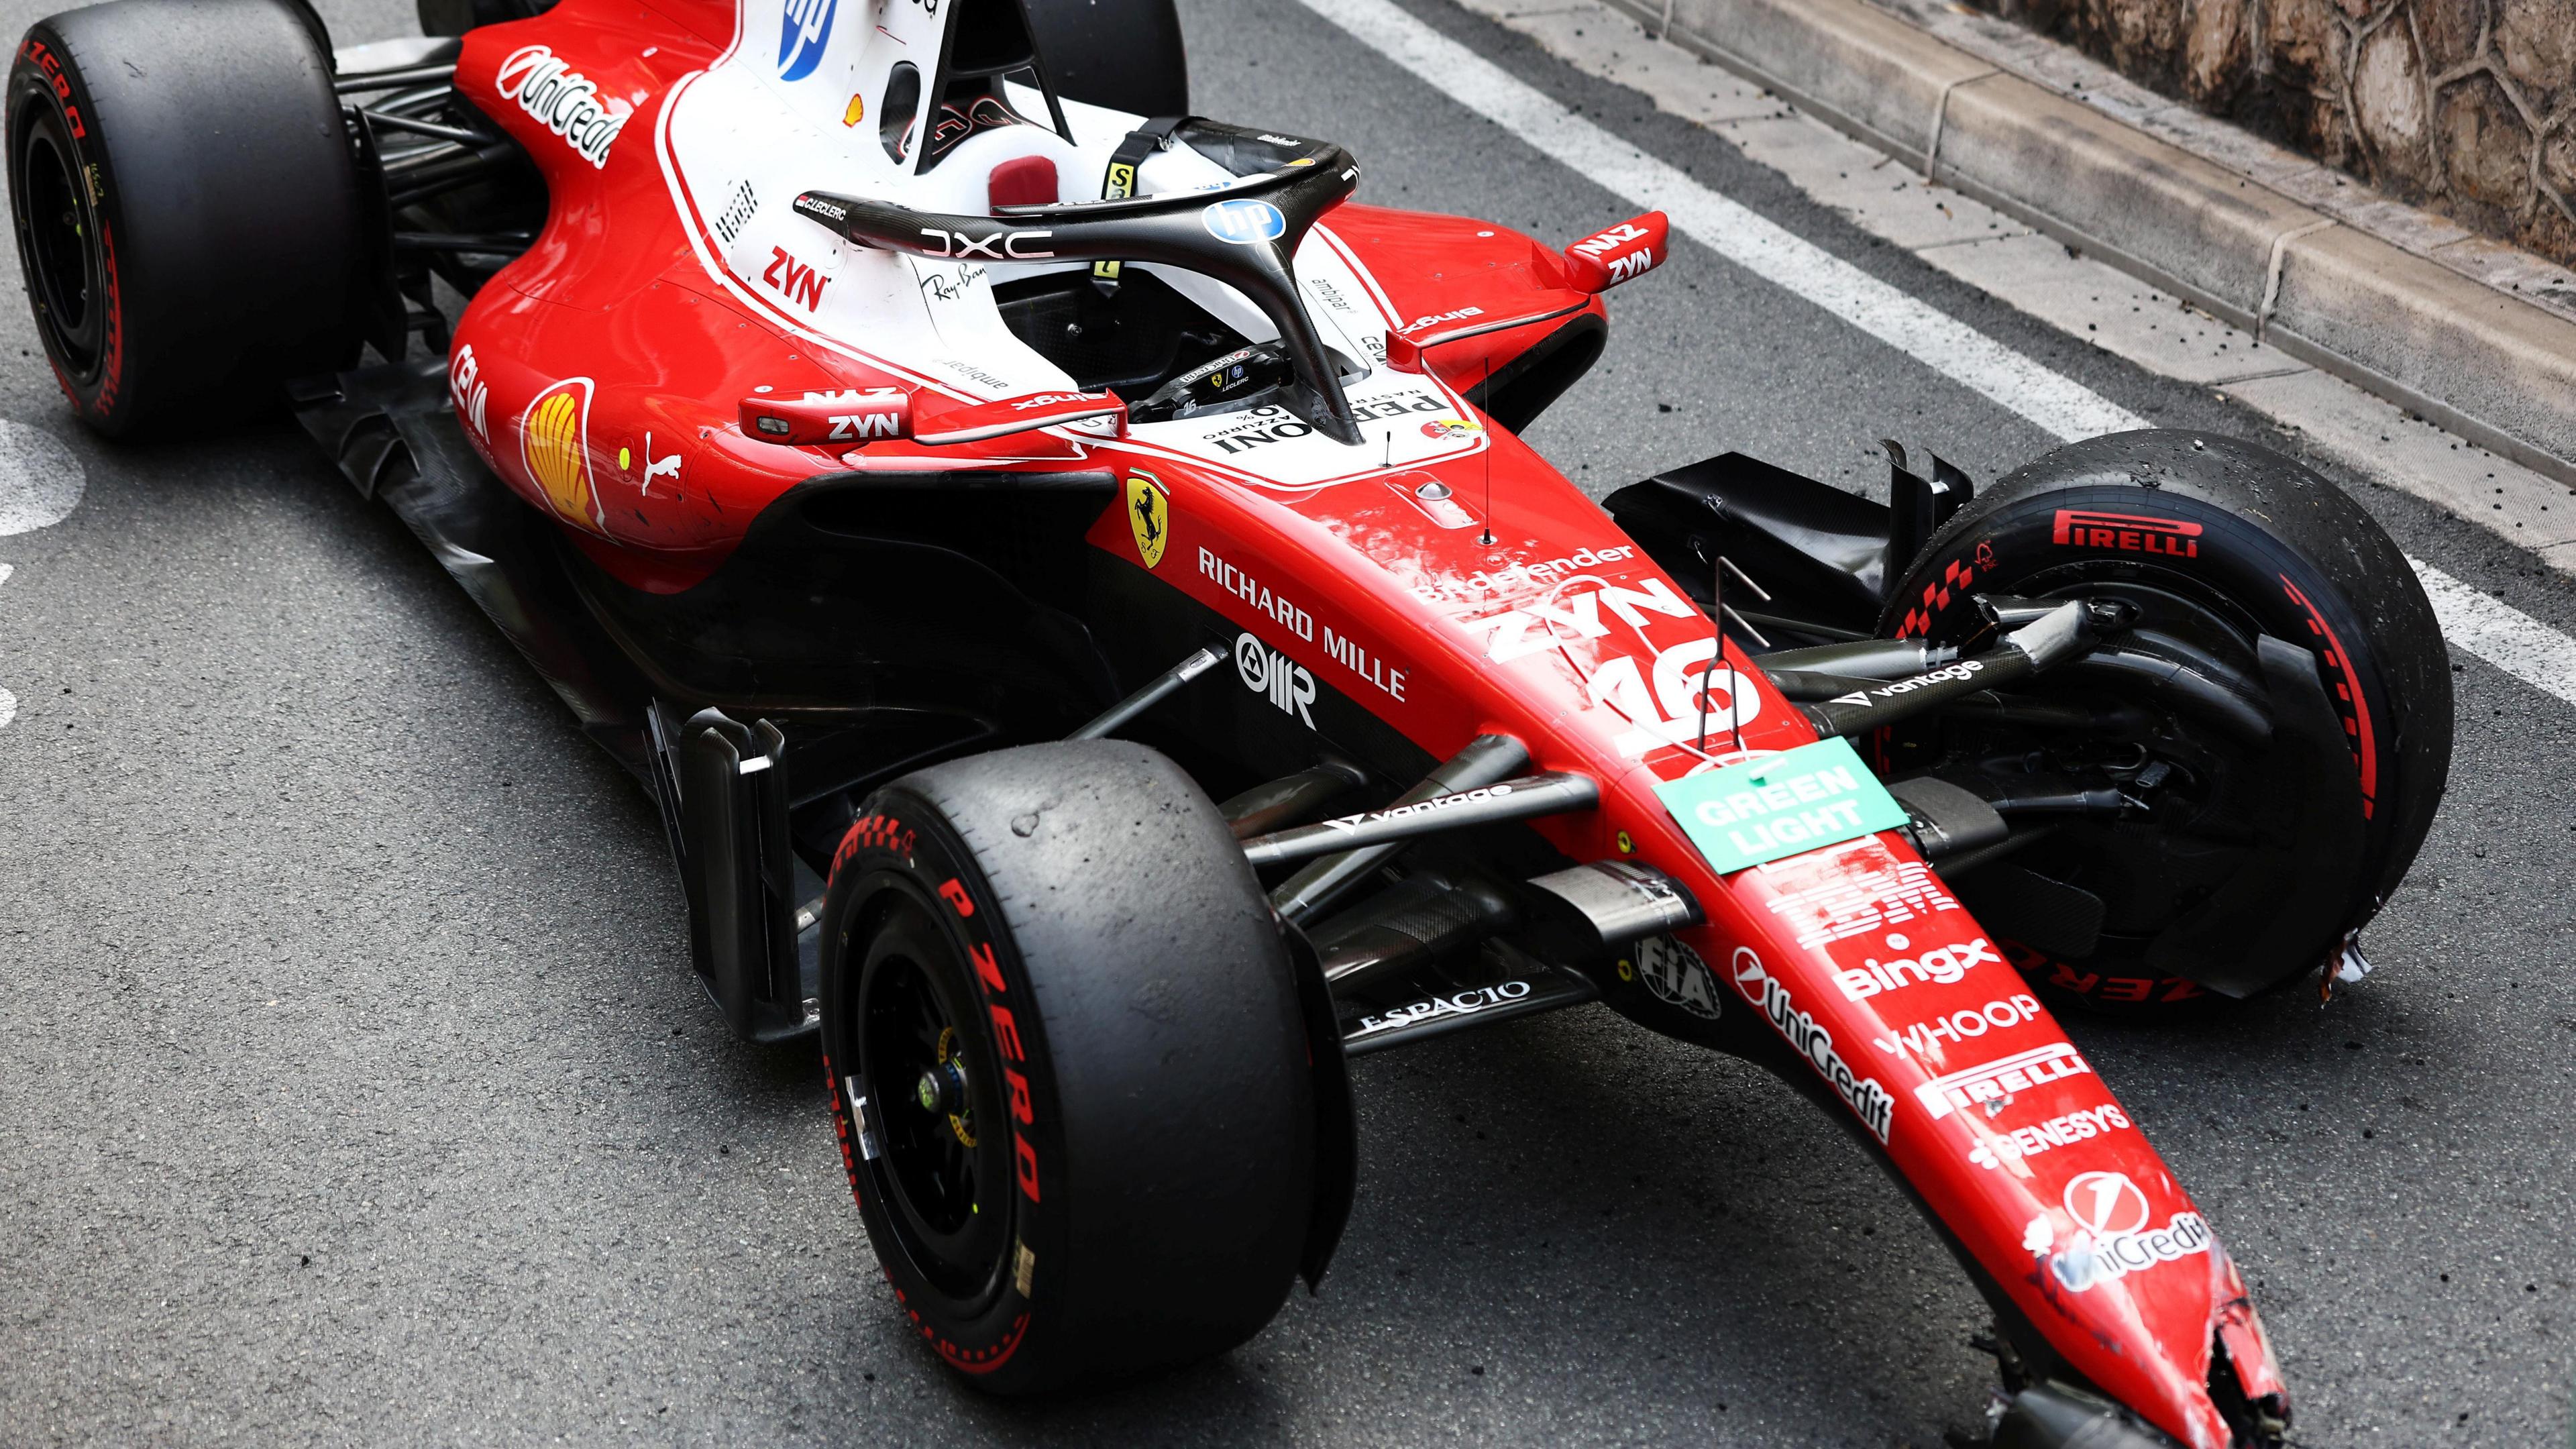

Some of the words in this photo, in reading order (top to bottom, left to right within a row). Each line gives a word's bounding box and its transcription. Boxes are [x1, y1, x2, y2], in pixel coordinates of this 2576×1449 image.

[28, 41, 86, 139] ZERO
[921, 228, 1055, 259] DXC
[1214, 201, 1273, 243] hp
[763, 246, 827, 313] ZYN
[922, 263, 986, 301] Ray-Ban
[1608, 248, 1651, 285] ZYN
[1183, 399, 1197, 416] 16
[1222, 376, 1249, 392] LECLERC
[828, 413, 899, 440] ZYN
[1202, 415, 1291, 440] AZZURRO
[2053, 509, 2203, 559] PIRELLI
[1408, 545, 1635, 606] Bitdefender
[1199, 545, 1313, 642] RICHARD
[1324, 627, 1405, 703] MILLE
[1458, 578, 1697, 665] ZYN
[1585, 638, 1761, 759] 16
[1870, 660, 1984, 697] vantage
[1371, 784, 1513, 824] vantage
[1695, 765, 1860, 826] GREEN
[1728, 799, 1863, 857] LIGHT
[1766, 861, 1960, 950] IBM
[1642, 936, 1715, 1012] FIA
[1359, 980, 1531, 1033] ESPACIO
[1873, 994, 2041, 1060] WHOOP
[969, 943, 1040, 1203] ZERO
[1767, 981, 1888, 1139] UniCredit
[1913, 1042, 2093, 1120] PIRELLI
[1992, 1104, 2131, 1161] GENESYS
